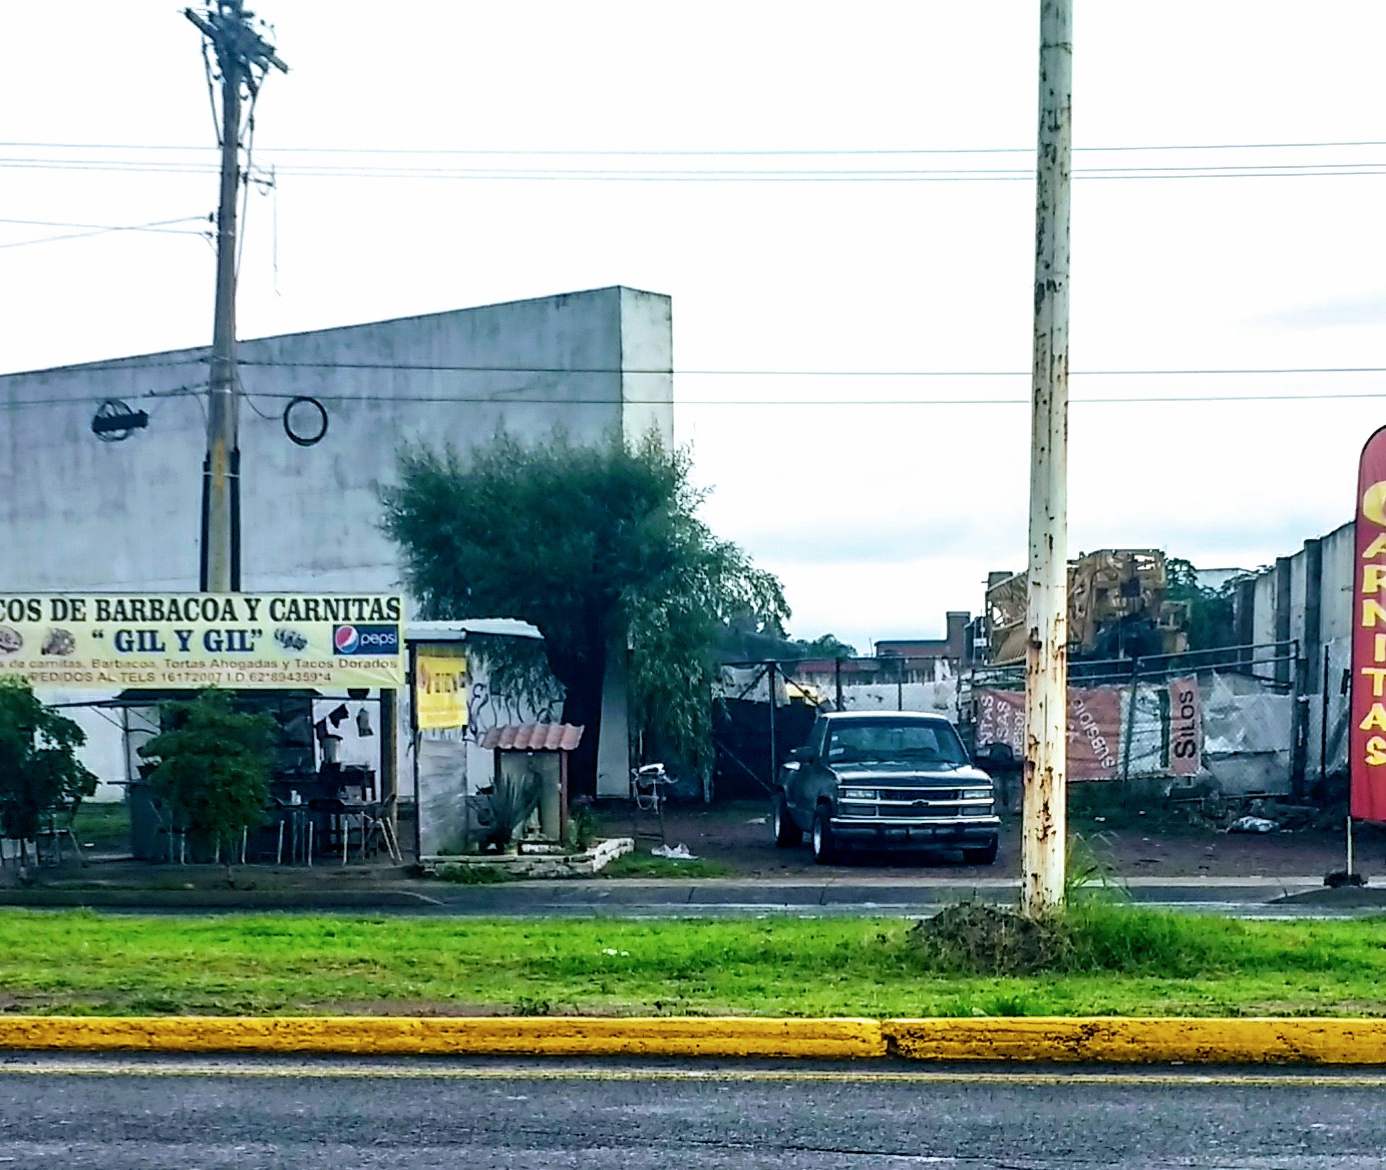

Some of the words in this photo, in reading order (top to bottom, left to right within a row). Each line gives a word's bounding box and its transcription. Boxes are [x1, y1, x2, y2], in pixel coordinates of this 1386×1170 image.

[50, 599, 87, 622] DE
[94, 598, 238, 622] BARBACOA
[244, 598, 262, 622] Y
[269, 597, 401, 622] CARNITAS
[174, 629, 194, 652] Y
[360, 633, 397, 646] pepsi
[9, 658, 25, 669] de
[164, 659, 206, 669] Tortas
[210, 659, 278, 670] Ahogadas
[282, 661, 291, 671] y
[295, 659, 334, 669] Tacos
[339, 658, 398, 669] Dorados
[120, 672, 155, 683] TELS
[979, 695, 995, 756] NTAS
[996, 701, 1011, 742] SAS
[1173, 690, 1196, 759] SILOS
